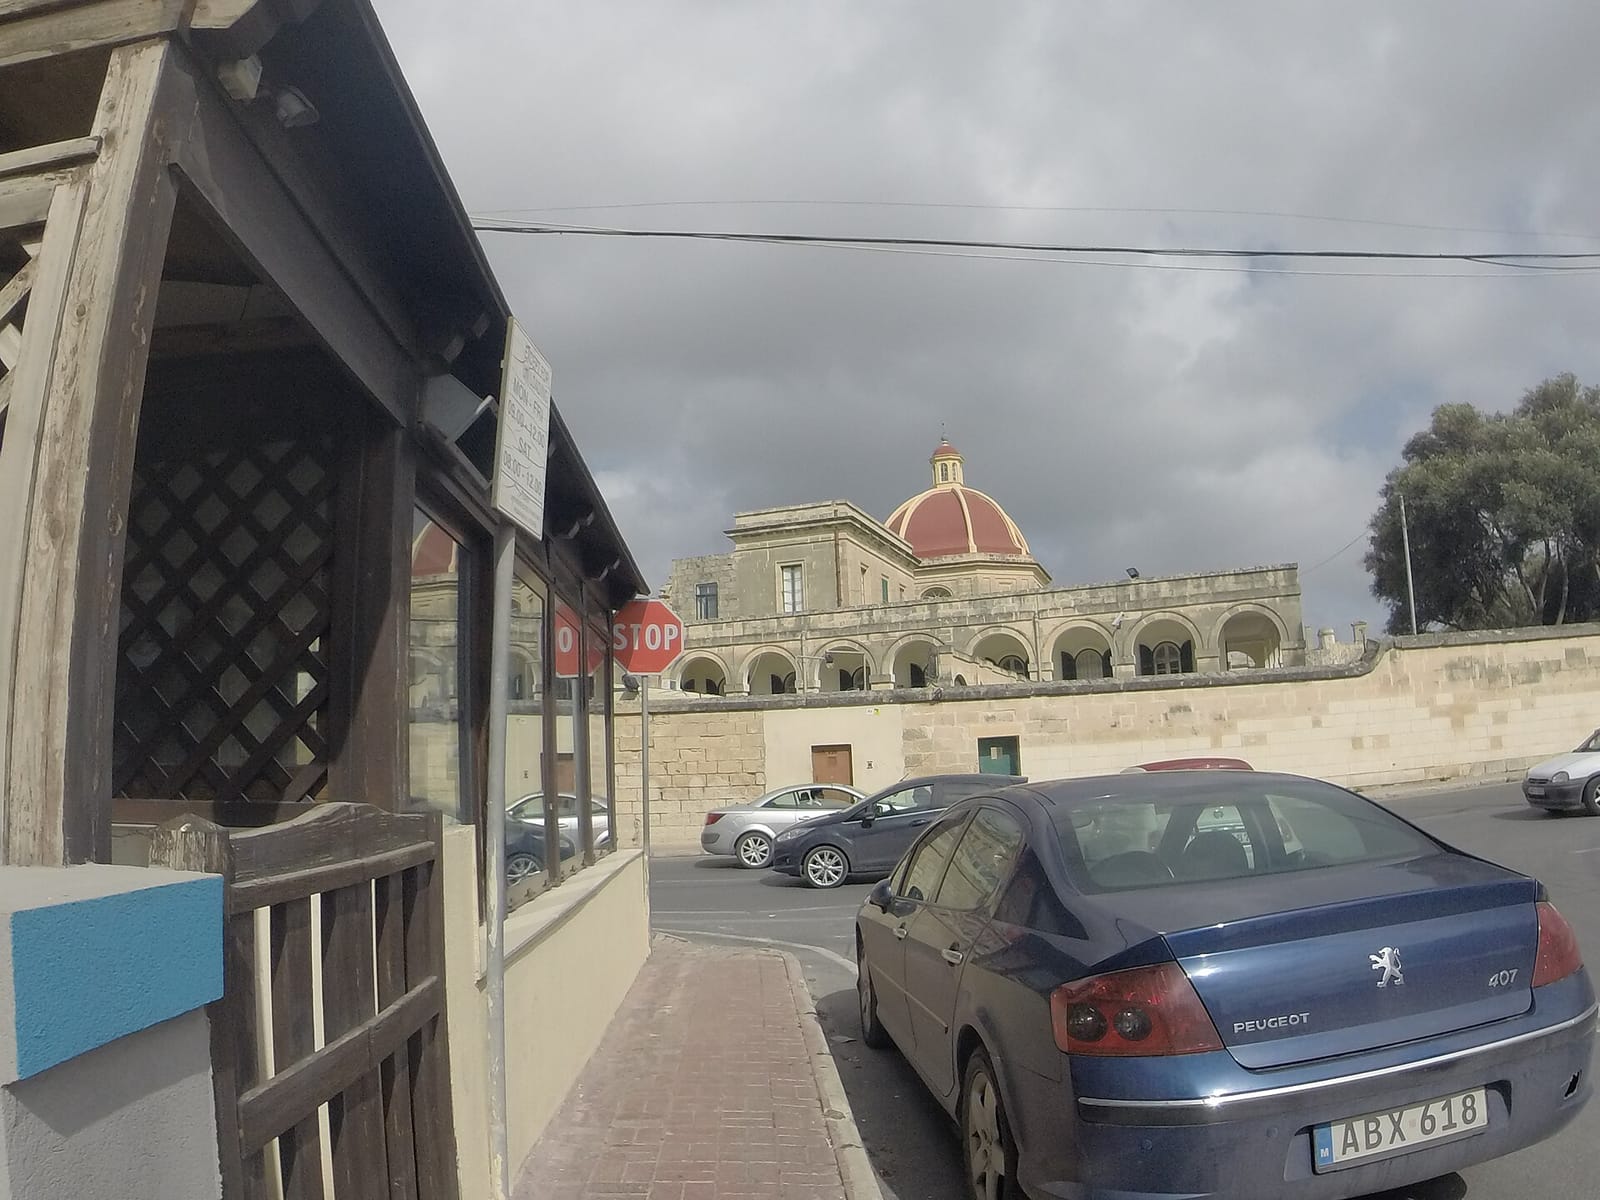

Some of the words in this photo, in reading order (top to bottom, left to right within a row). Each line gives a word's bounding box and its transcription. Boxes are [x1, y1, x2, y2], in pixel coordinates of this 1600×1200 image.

[613, 623, 679, 651] STOP
[1488, 968, 1519, 988] 407
[1233, 1012, 1310, 1034] PEUGEOT
[1341, 1109, 1406, 1156] ABX
[1420, 1094, 1477, 1136] 618
[1320, 1147, 1329, 1158] M
